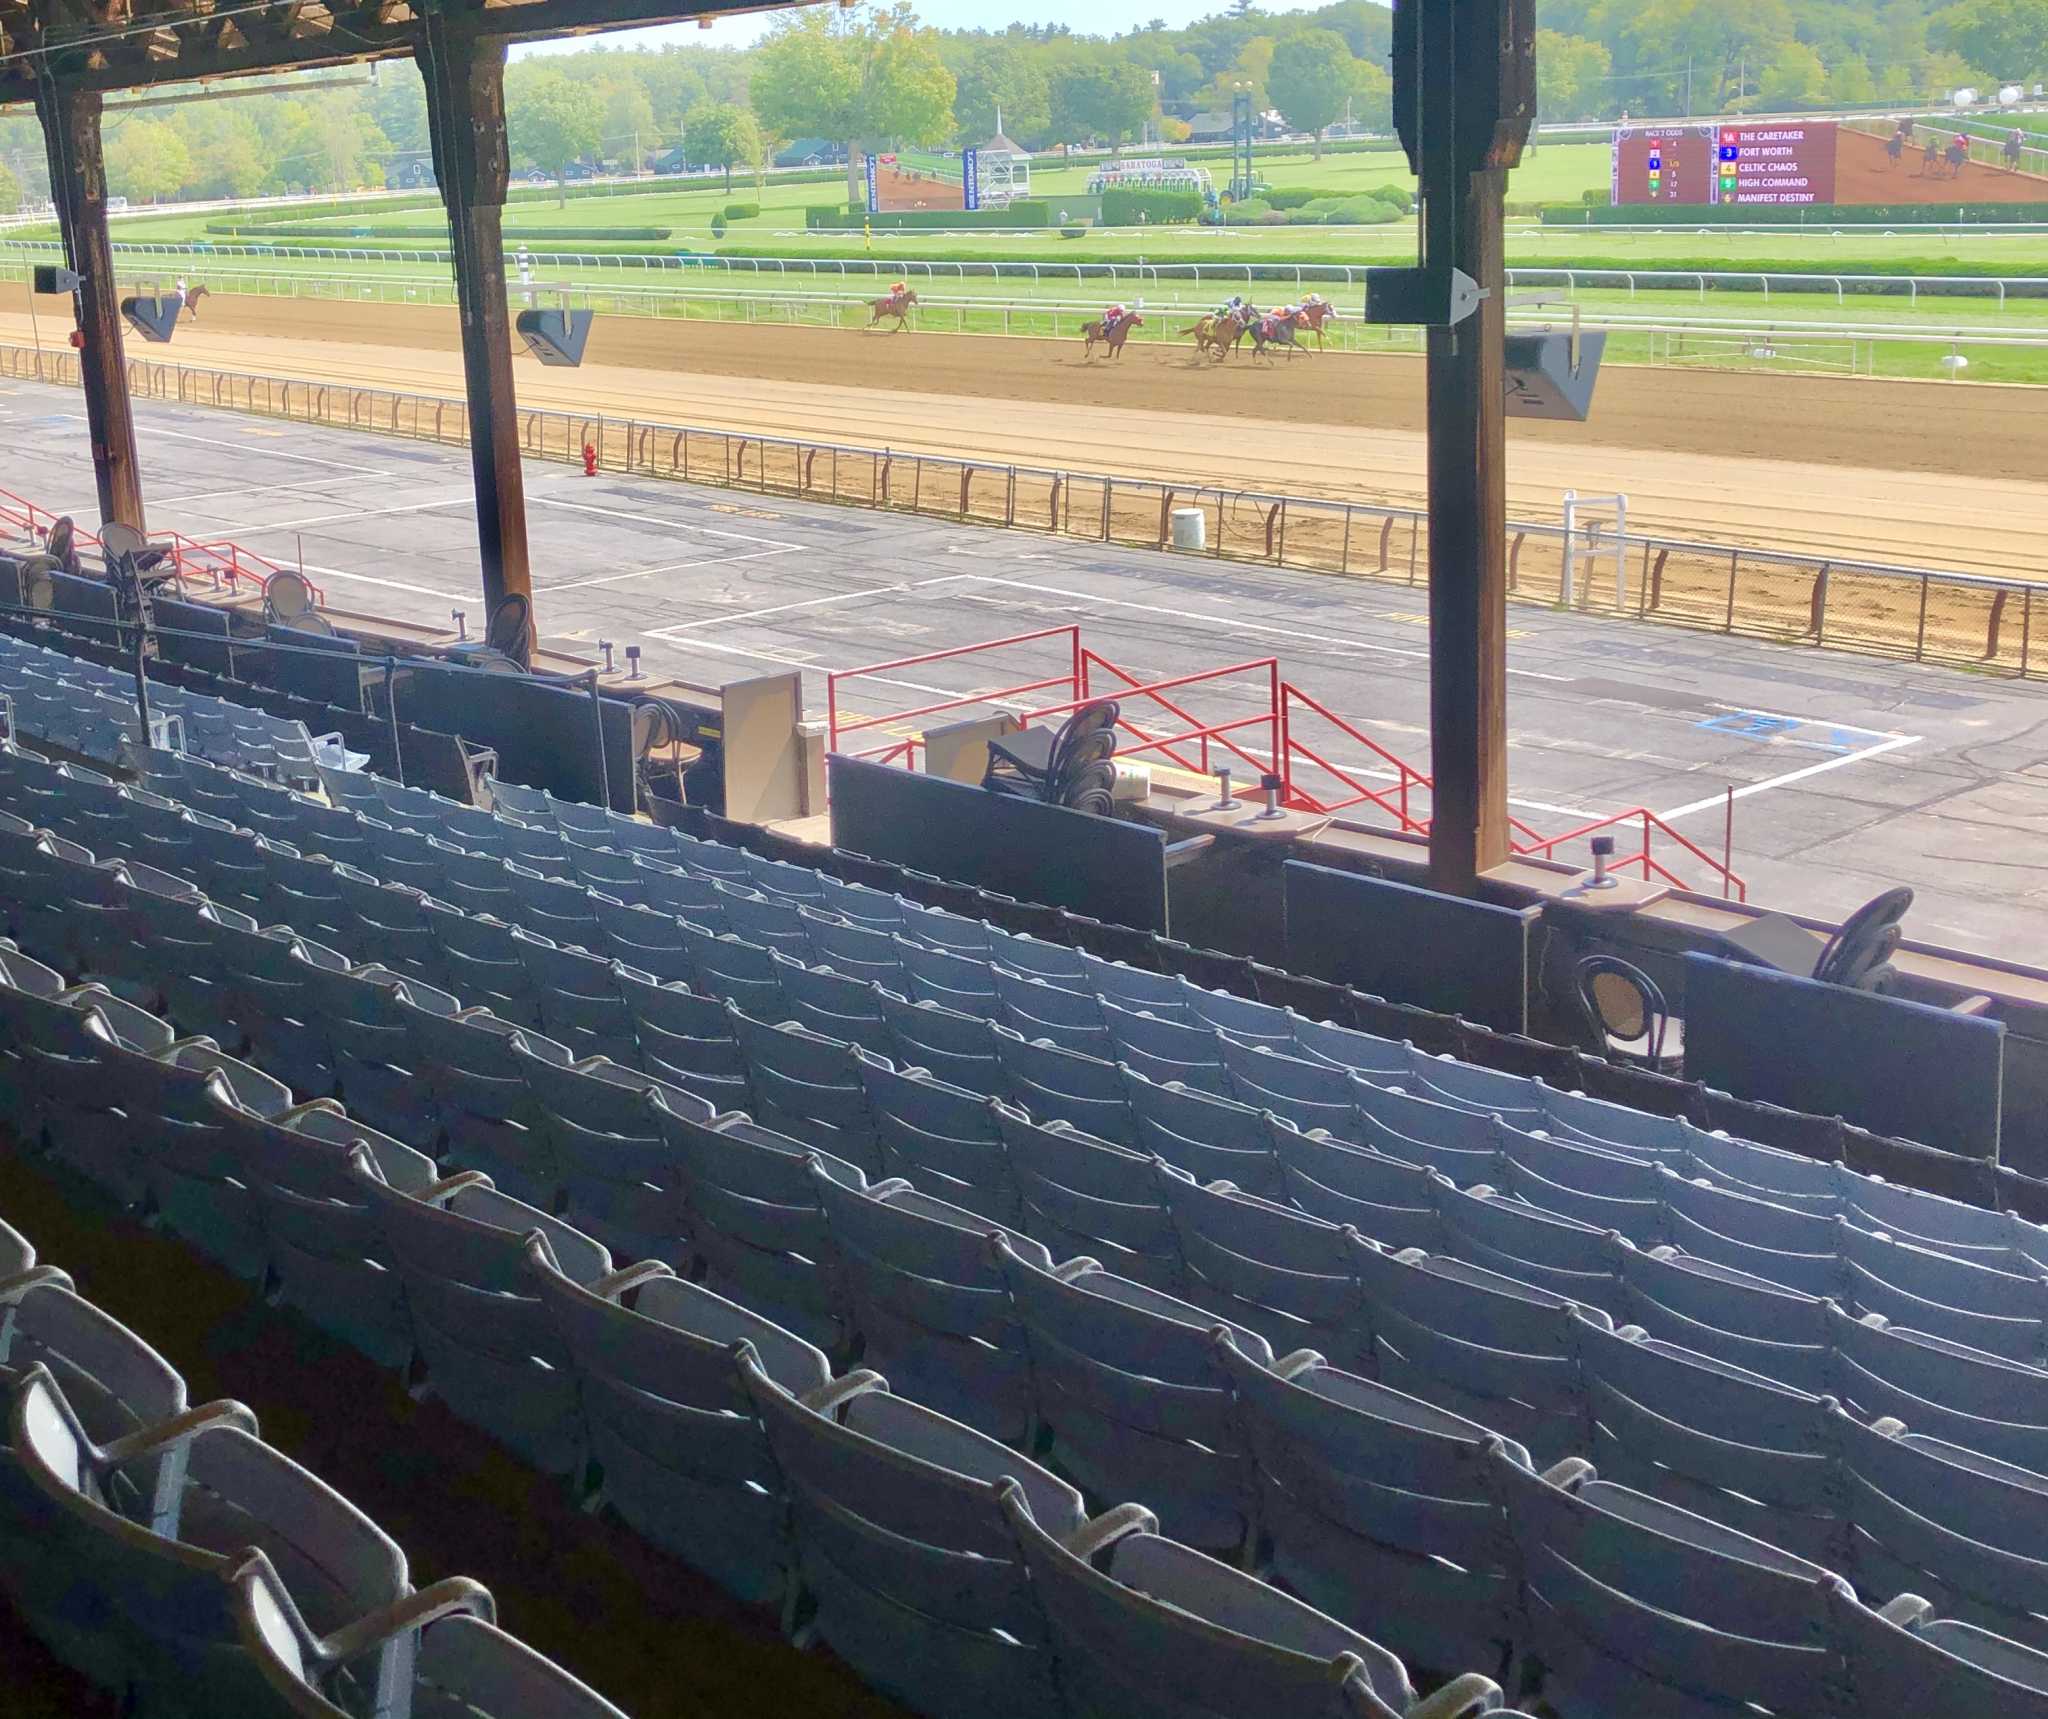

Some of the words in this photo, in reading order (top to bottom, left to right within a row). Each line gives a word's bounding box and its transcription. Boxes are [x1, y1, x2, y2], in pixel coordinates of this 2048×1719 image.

[1724, 133, 1734, 142] 1A
[1739, 132, 1756, 141] THE
[1757, 131, 1804, 140] CARETAKER
[1726, 148, 1733, 157] 3
[1739, 147, 1760, 157] FORT
[1761, 146, 1793, 156] WORTH
[1120, 160, 1163, 170] SARATOGA
[1739, 163, 1766, 172] CELTIC
[1767, 162, 1798, 172] CHAOS
[967, 151, 976, 209] LONGINES
[1738, 178, 1760, 187] HIGH
[1761, 177, 1808, 187] COMMAND
[1737, 193, 1778, 203] MANIFEST
[1779, 193, 1815, 202] DESTINY
